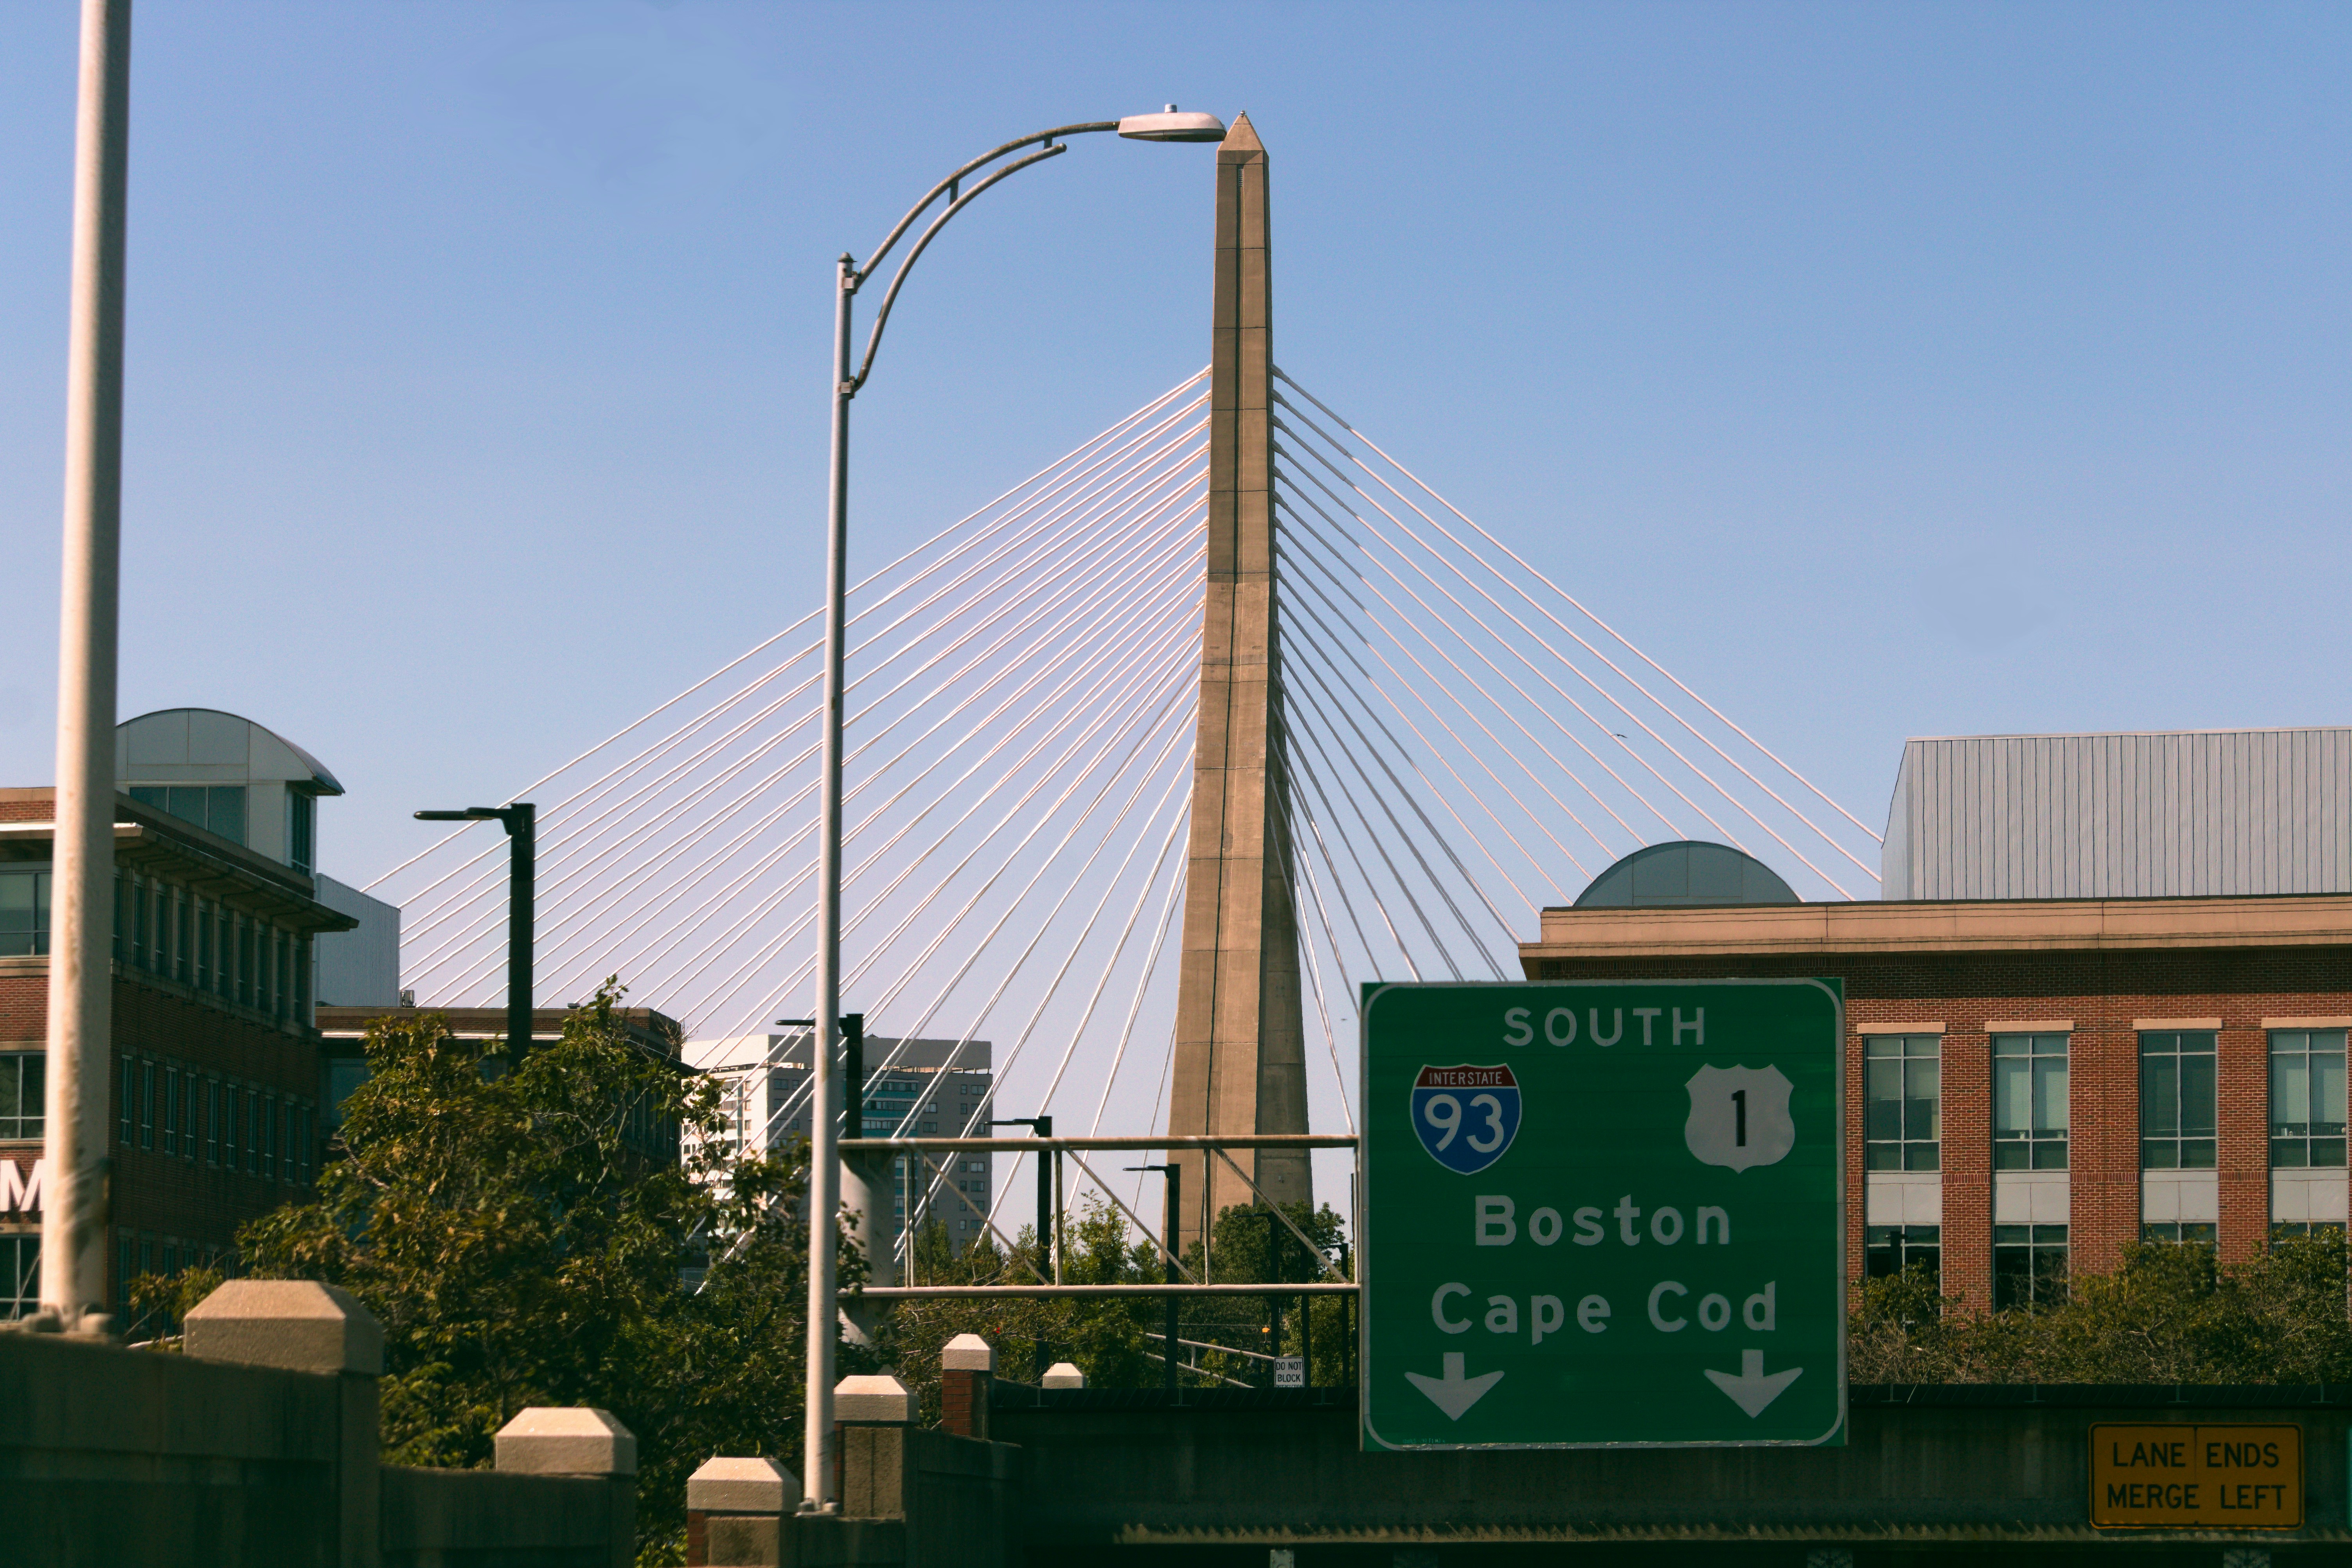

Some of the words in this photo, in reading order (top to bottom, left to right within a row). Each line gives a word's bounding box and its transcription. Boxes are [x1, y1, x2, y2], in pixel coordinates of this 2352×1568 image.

[1503, 1007, 1705, 1047] SOUTH
[1429, 1072, 1502, 1085] INTERSTATE
[1424, 1094, 1504, 1153] 93
[1731, 1090, 1746, 1147] 1
[1475, 1194, 1730, 1246] Boston
[1431, 1282, 1611, 1346] Cape
[1647, 1280, 1776, 1332] Cod
[1276, 1362, 1285, 1370] DO
[1288, 1361, 1302, 1370] NOT
[1277, 1374, 1300, 1382] BLOCK
[2113, 1442, 2186, 1467] LANE
[2206, 1442, 2280, 1468] ENDS
[2107, 1484, 2200, 1510] MERGE
[2220, 1485, 2287, 1510] LEFT
